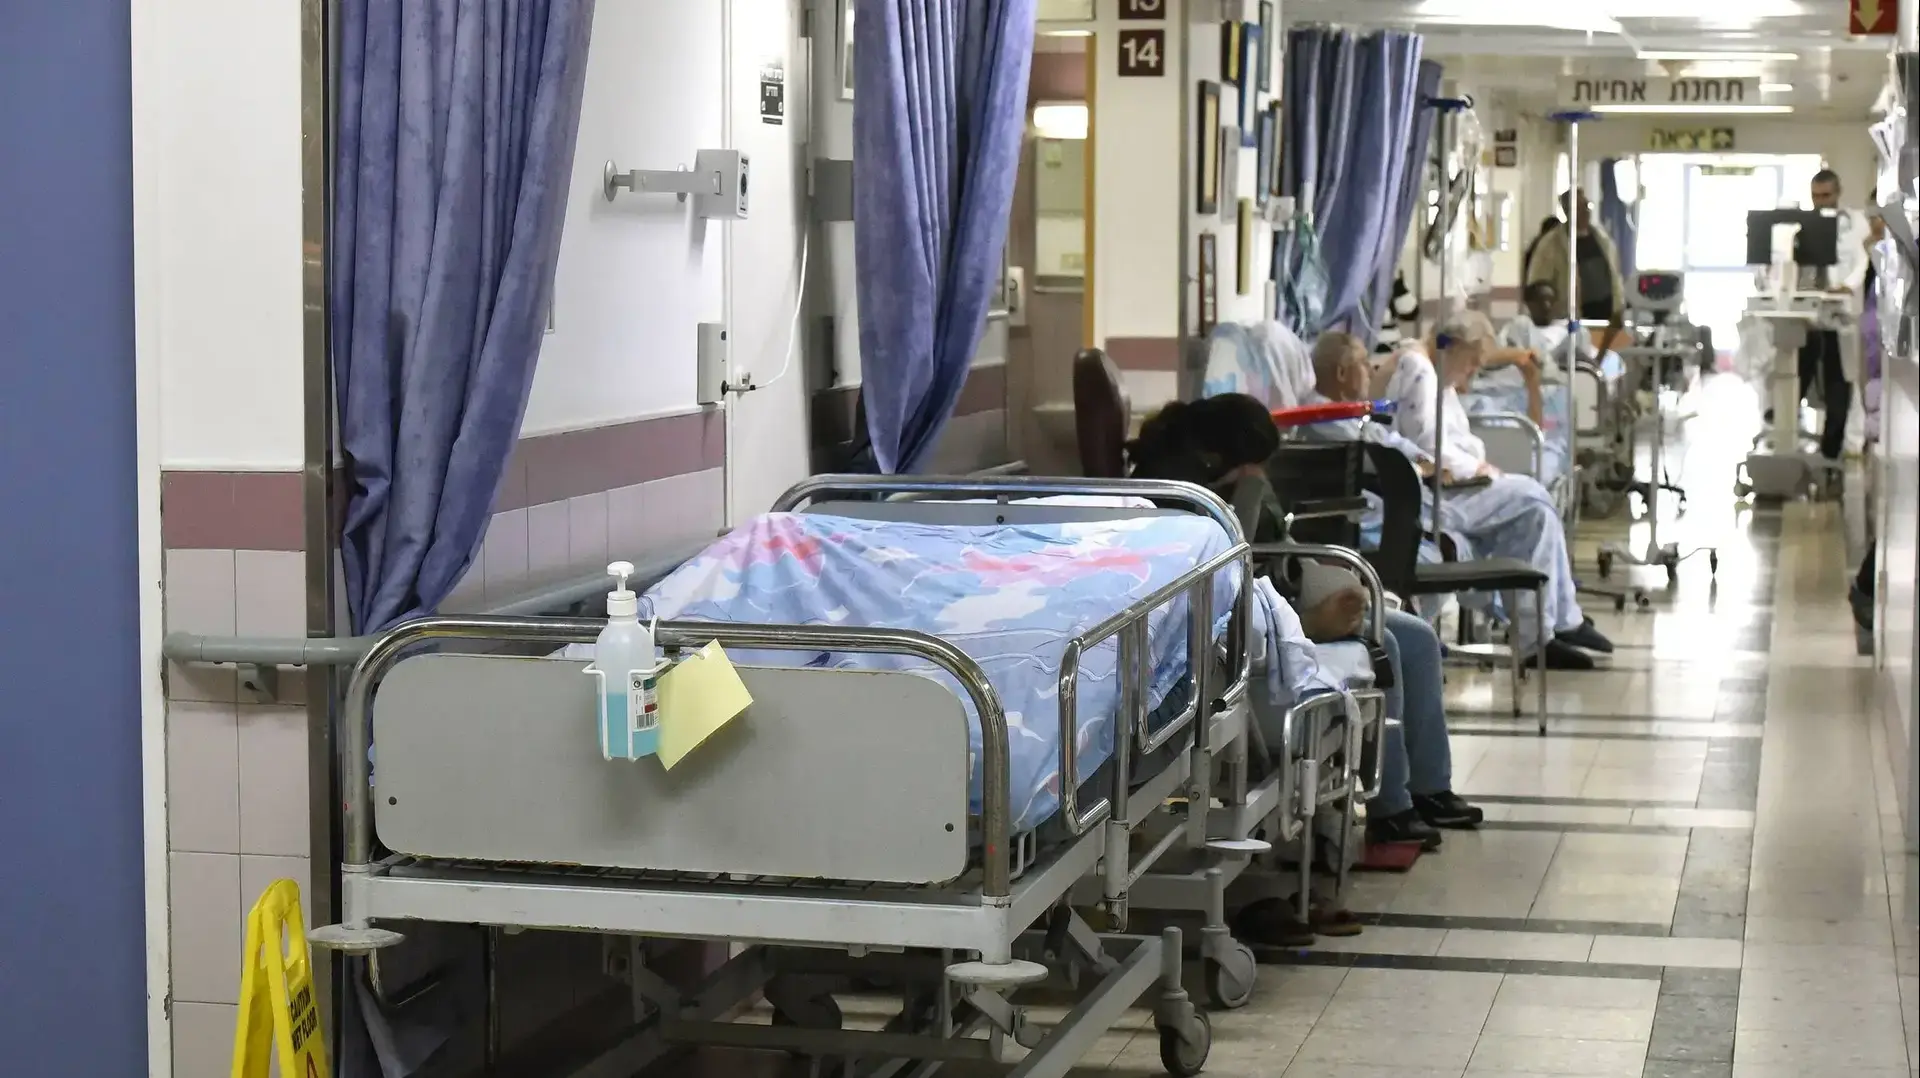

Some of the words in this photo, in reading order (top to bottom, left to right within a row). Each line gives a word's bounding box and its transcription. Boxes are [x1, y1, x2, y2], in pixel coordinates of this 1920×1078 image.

[1122, 37, 1160, 68] 14
[1573, 79, 1647, 101] אחיות
[1670, 79, 1744, 101] תחנת
[290, 984, 311, 1024] CAUTION
[301, 1006, 318, 1043] FLOOR
